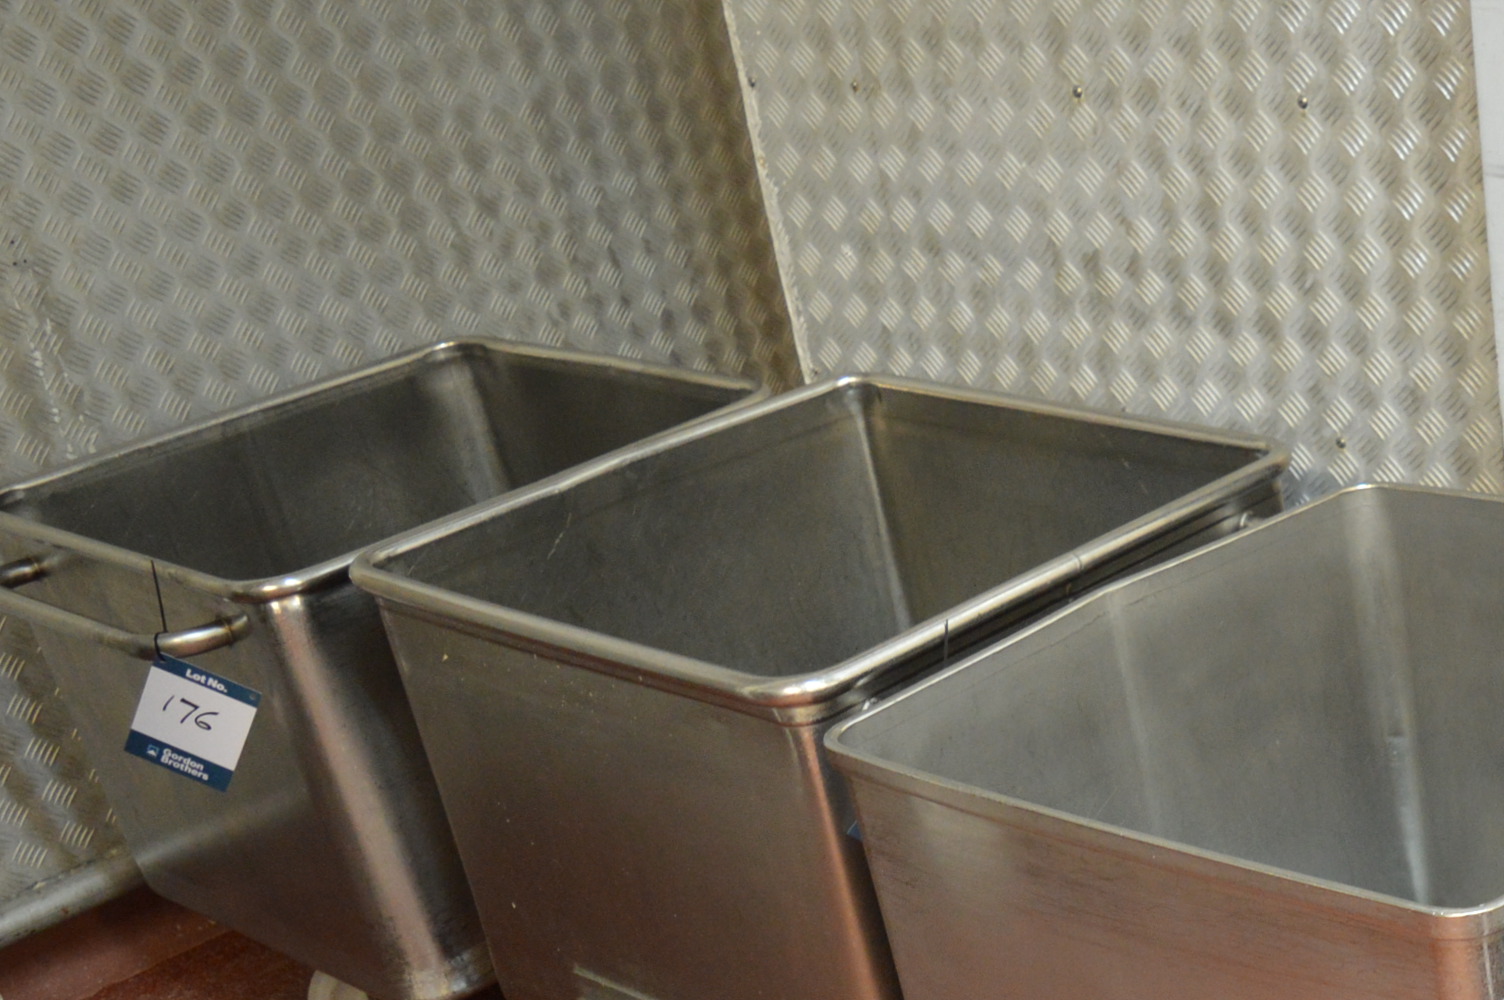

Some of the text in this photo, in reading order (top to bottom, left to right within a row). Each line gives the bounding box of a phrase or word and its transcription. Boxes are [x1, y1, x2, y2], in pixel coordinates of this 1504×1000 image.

[185, 668, 228, 693] Lot No.
[162, 695, 220, 731] 176
[160, 754, 209, 781] Brothers
[163, 748, 204, 771] Gordon
